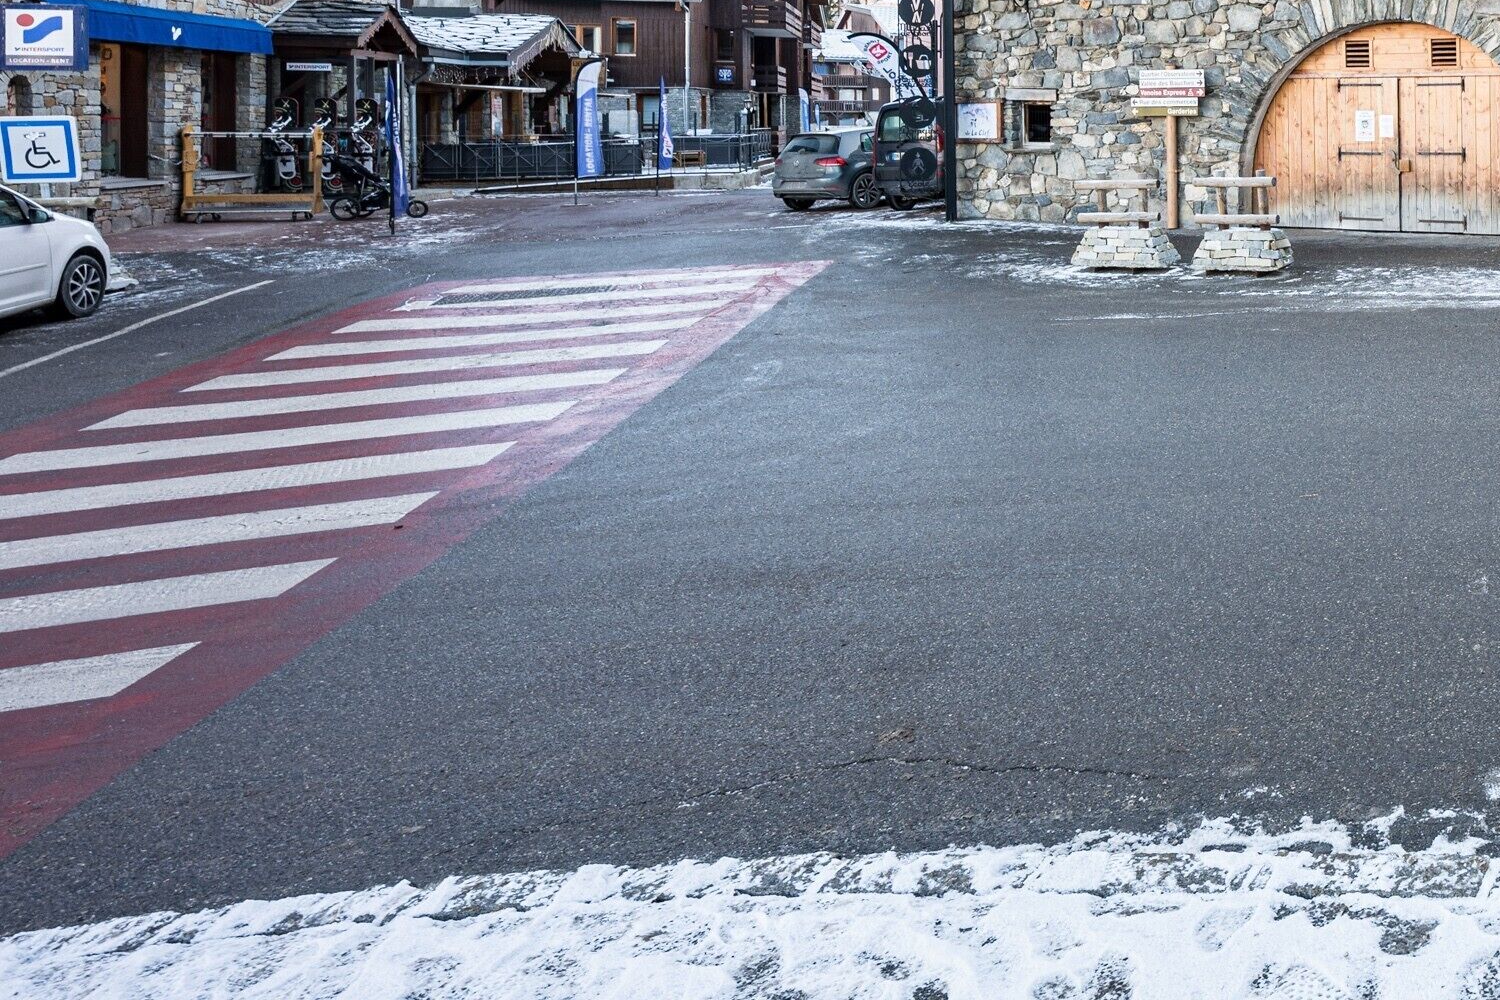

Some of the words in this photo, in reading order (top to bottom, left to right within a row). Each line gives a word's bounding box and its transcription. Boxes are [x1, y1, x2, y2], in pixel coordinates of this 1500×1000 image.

[1163, 89, 1187, 97] Express
[583, 98, 594, 127] RENTAL
[583, 133, 596, 173] LOCATION
